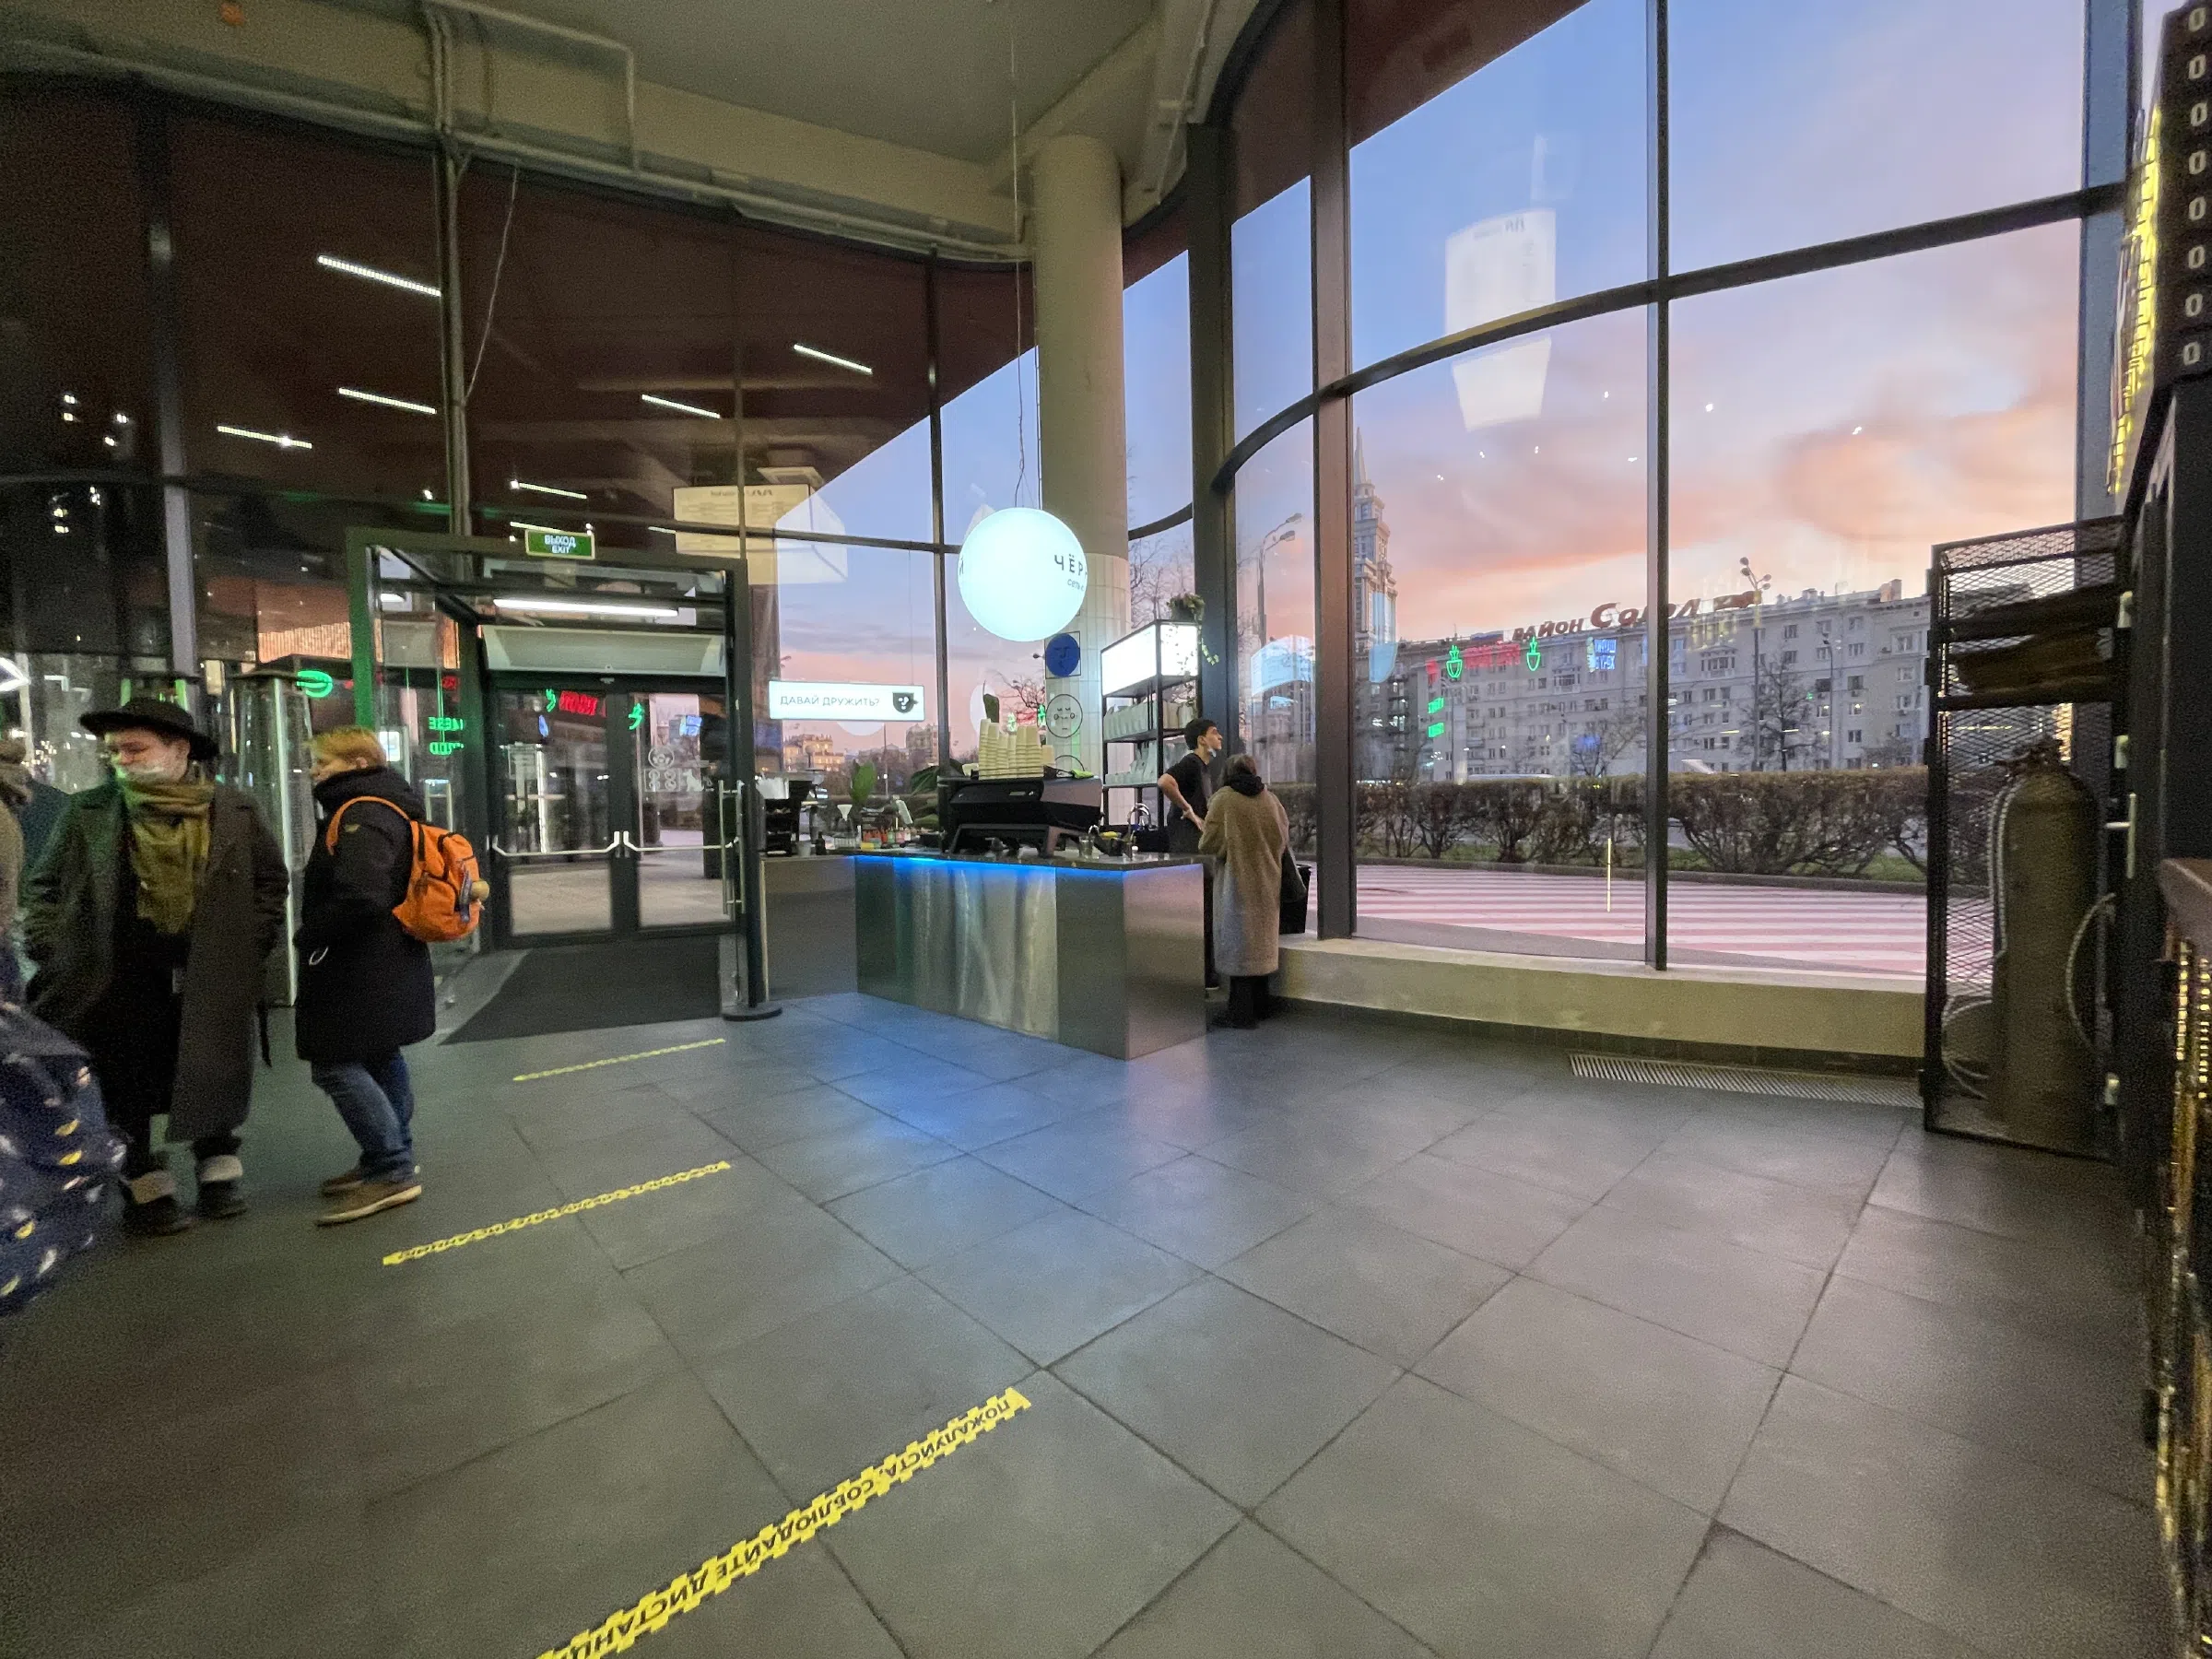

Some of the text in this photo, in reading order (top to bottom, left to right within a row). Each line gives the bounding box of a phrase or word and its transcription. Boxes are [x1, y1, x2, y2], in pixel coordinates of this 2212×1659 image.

[545, 535, 576, 547] ВЫХОД
[552, 545, 571, 553] EXIT
[781, 694, 880, 707] ДАВАЙ ДРУЖИТЬ?
[559, 1400, 1010, 1659] ПОЖАЛУЙСТА, СОБЛЮДАЙТЕ ДИСТАНЦ
